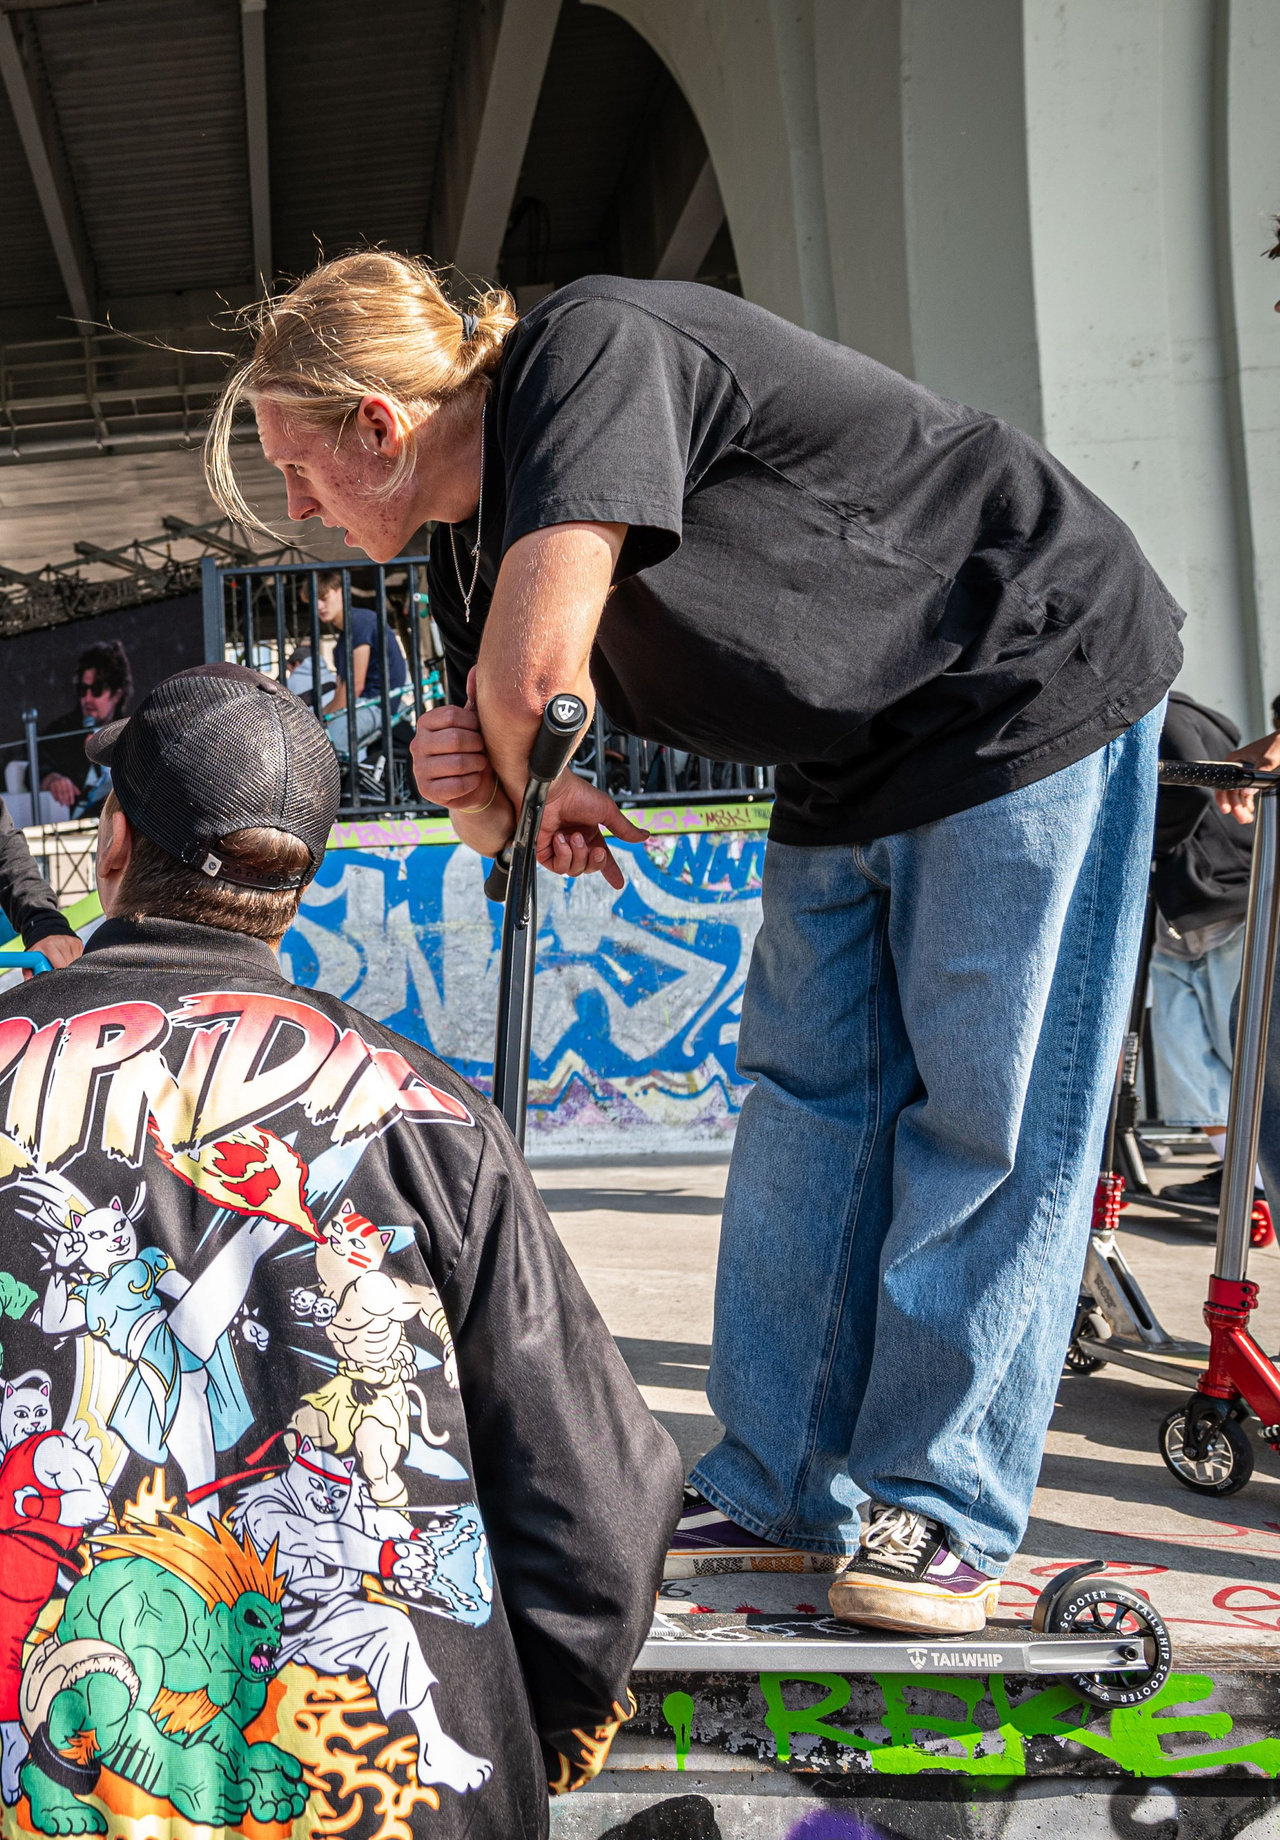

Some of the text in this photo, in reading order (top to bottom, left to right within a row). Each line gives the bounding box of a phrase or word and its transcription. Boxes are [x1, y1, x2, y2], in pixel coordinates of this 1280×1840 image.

[1060, 1590, 1108, 1629] SCOOTER
[1135, 1602, 1170, 1660] TAILWHIP
[930, 1652, 1004, 1668] TAILWHIP
[1120, 1664, 1168, 1703] SCOOTER
